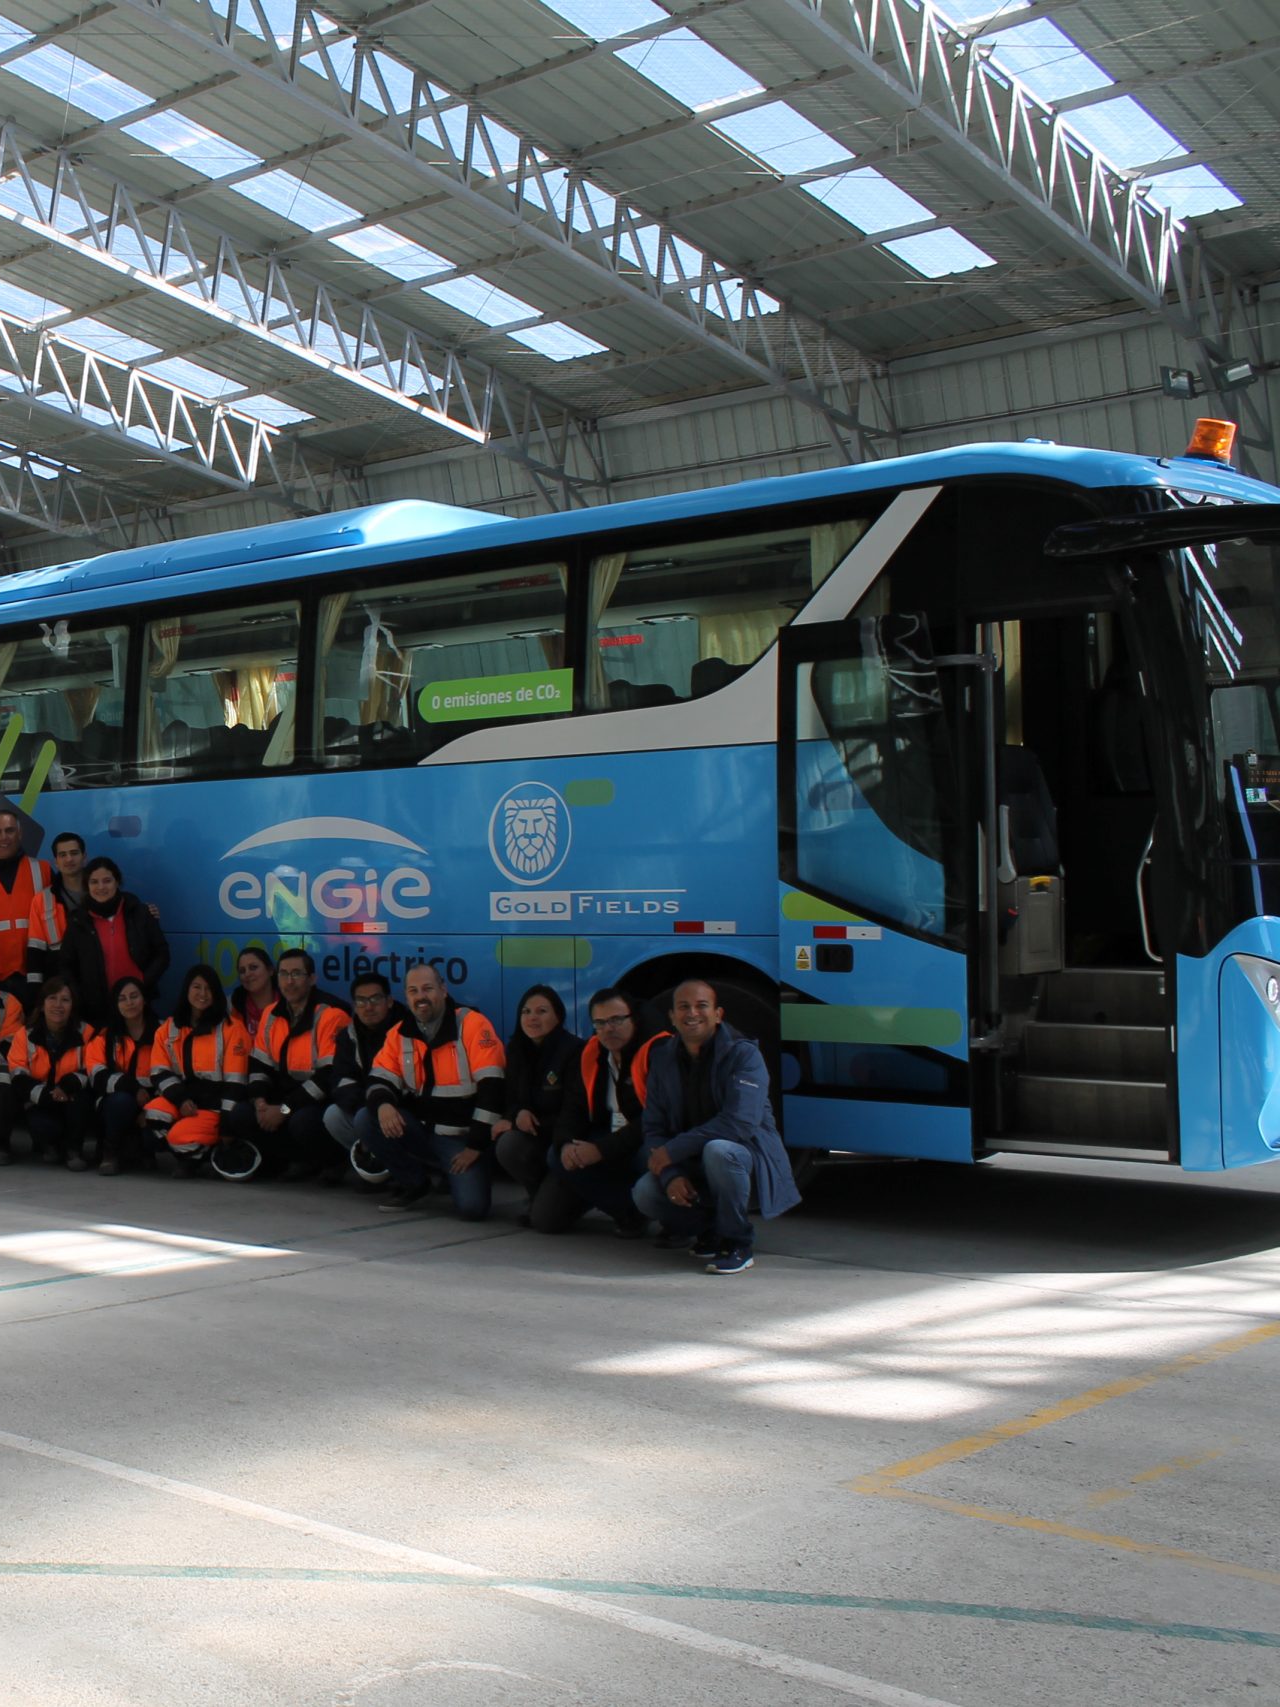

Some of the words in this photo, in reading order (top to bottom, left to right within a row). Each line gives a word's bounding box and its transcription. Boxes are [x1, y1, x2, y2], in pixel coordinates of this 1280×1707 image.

[431, 695, 441, 710] 0
[443, 690, 512, 709] emisiones
[515, 687, 534, 701] de
[196, 938, 312, 988] 10
